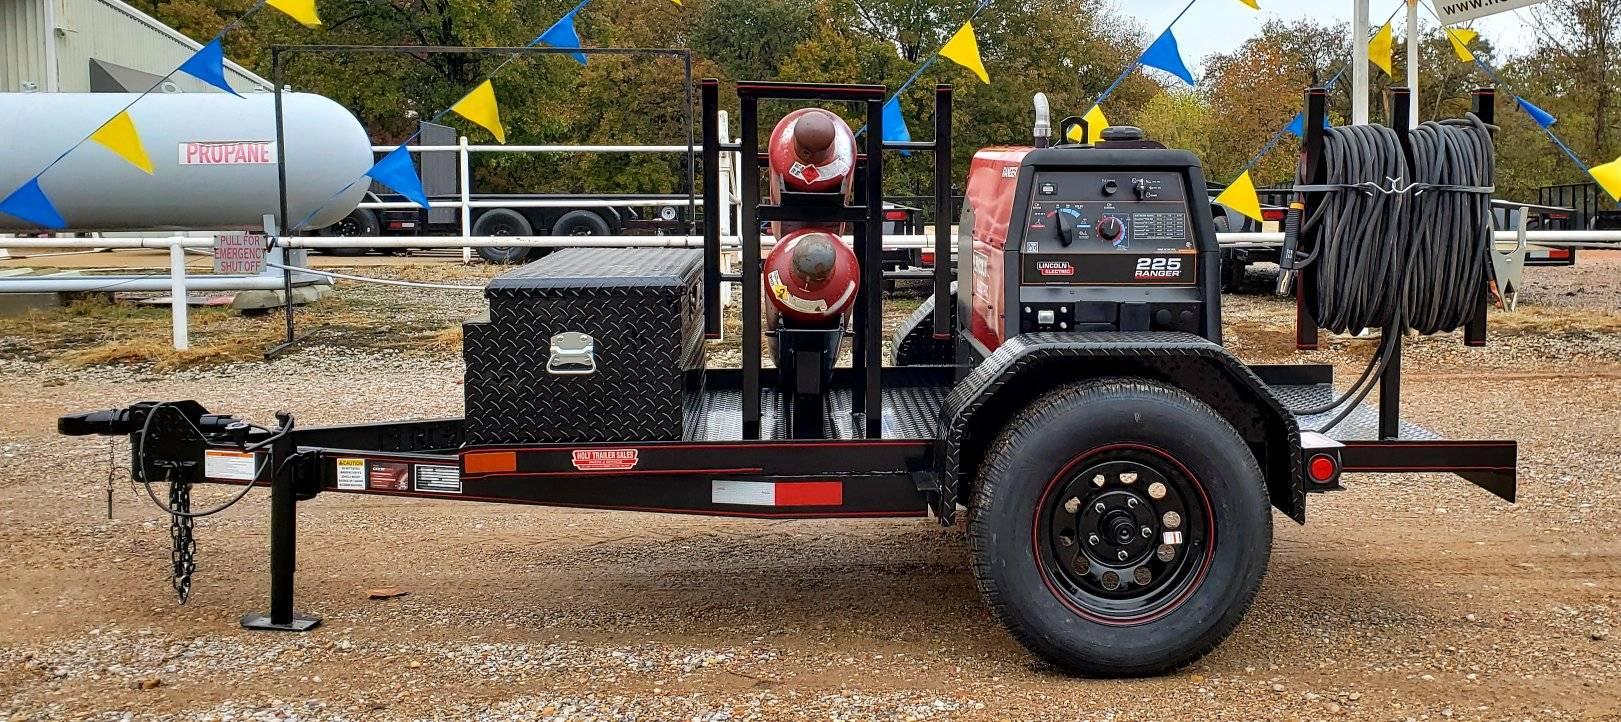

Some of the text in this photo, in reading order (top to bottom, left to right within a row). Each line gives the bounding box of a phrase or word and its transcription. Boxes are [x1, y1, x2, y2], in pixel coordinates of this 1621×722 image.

[1442, 0, 1509, 15] www.
[186, 143, 270, 163] PROPANE
[220, 235, 260, 246] PULL FOR
[214, 247, 266, 260] EMERGENCY
[220, 261, 261, 272] SHUT OFF
[1136, 257, 1182, 270] 225
[592, 451, 616, 460] TRAILER
[617, 450, 634, 459] SALES
